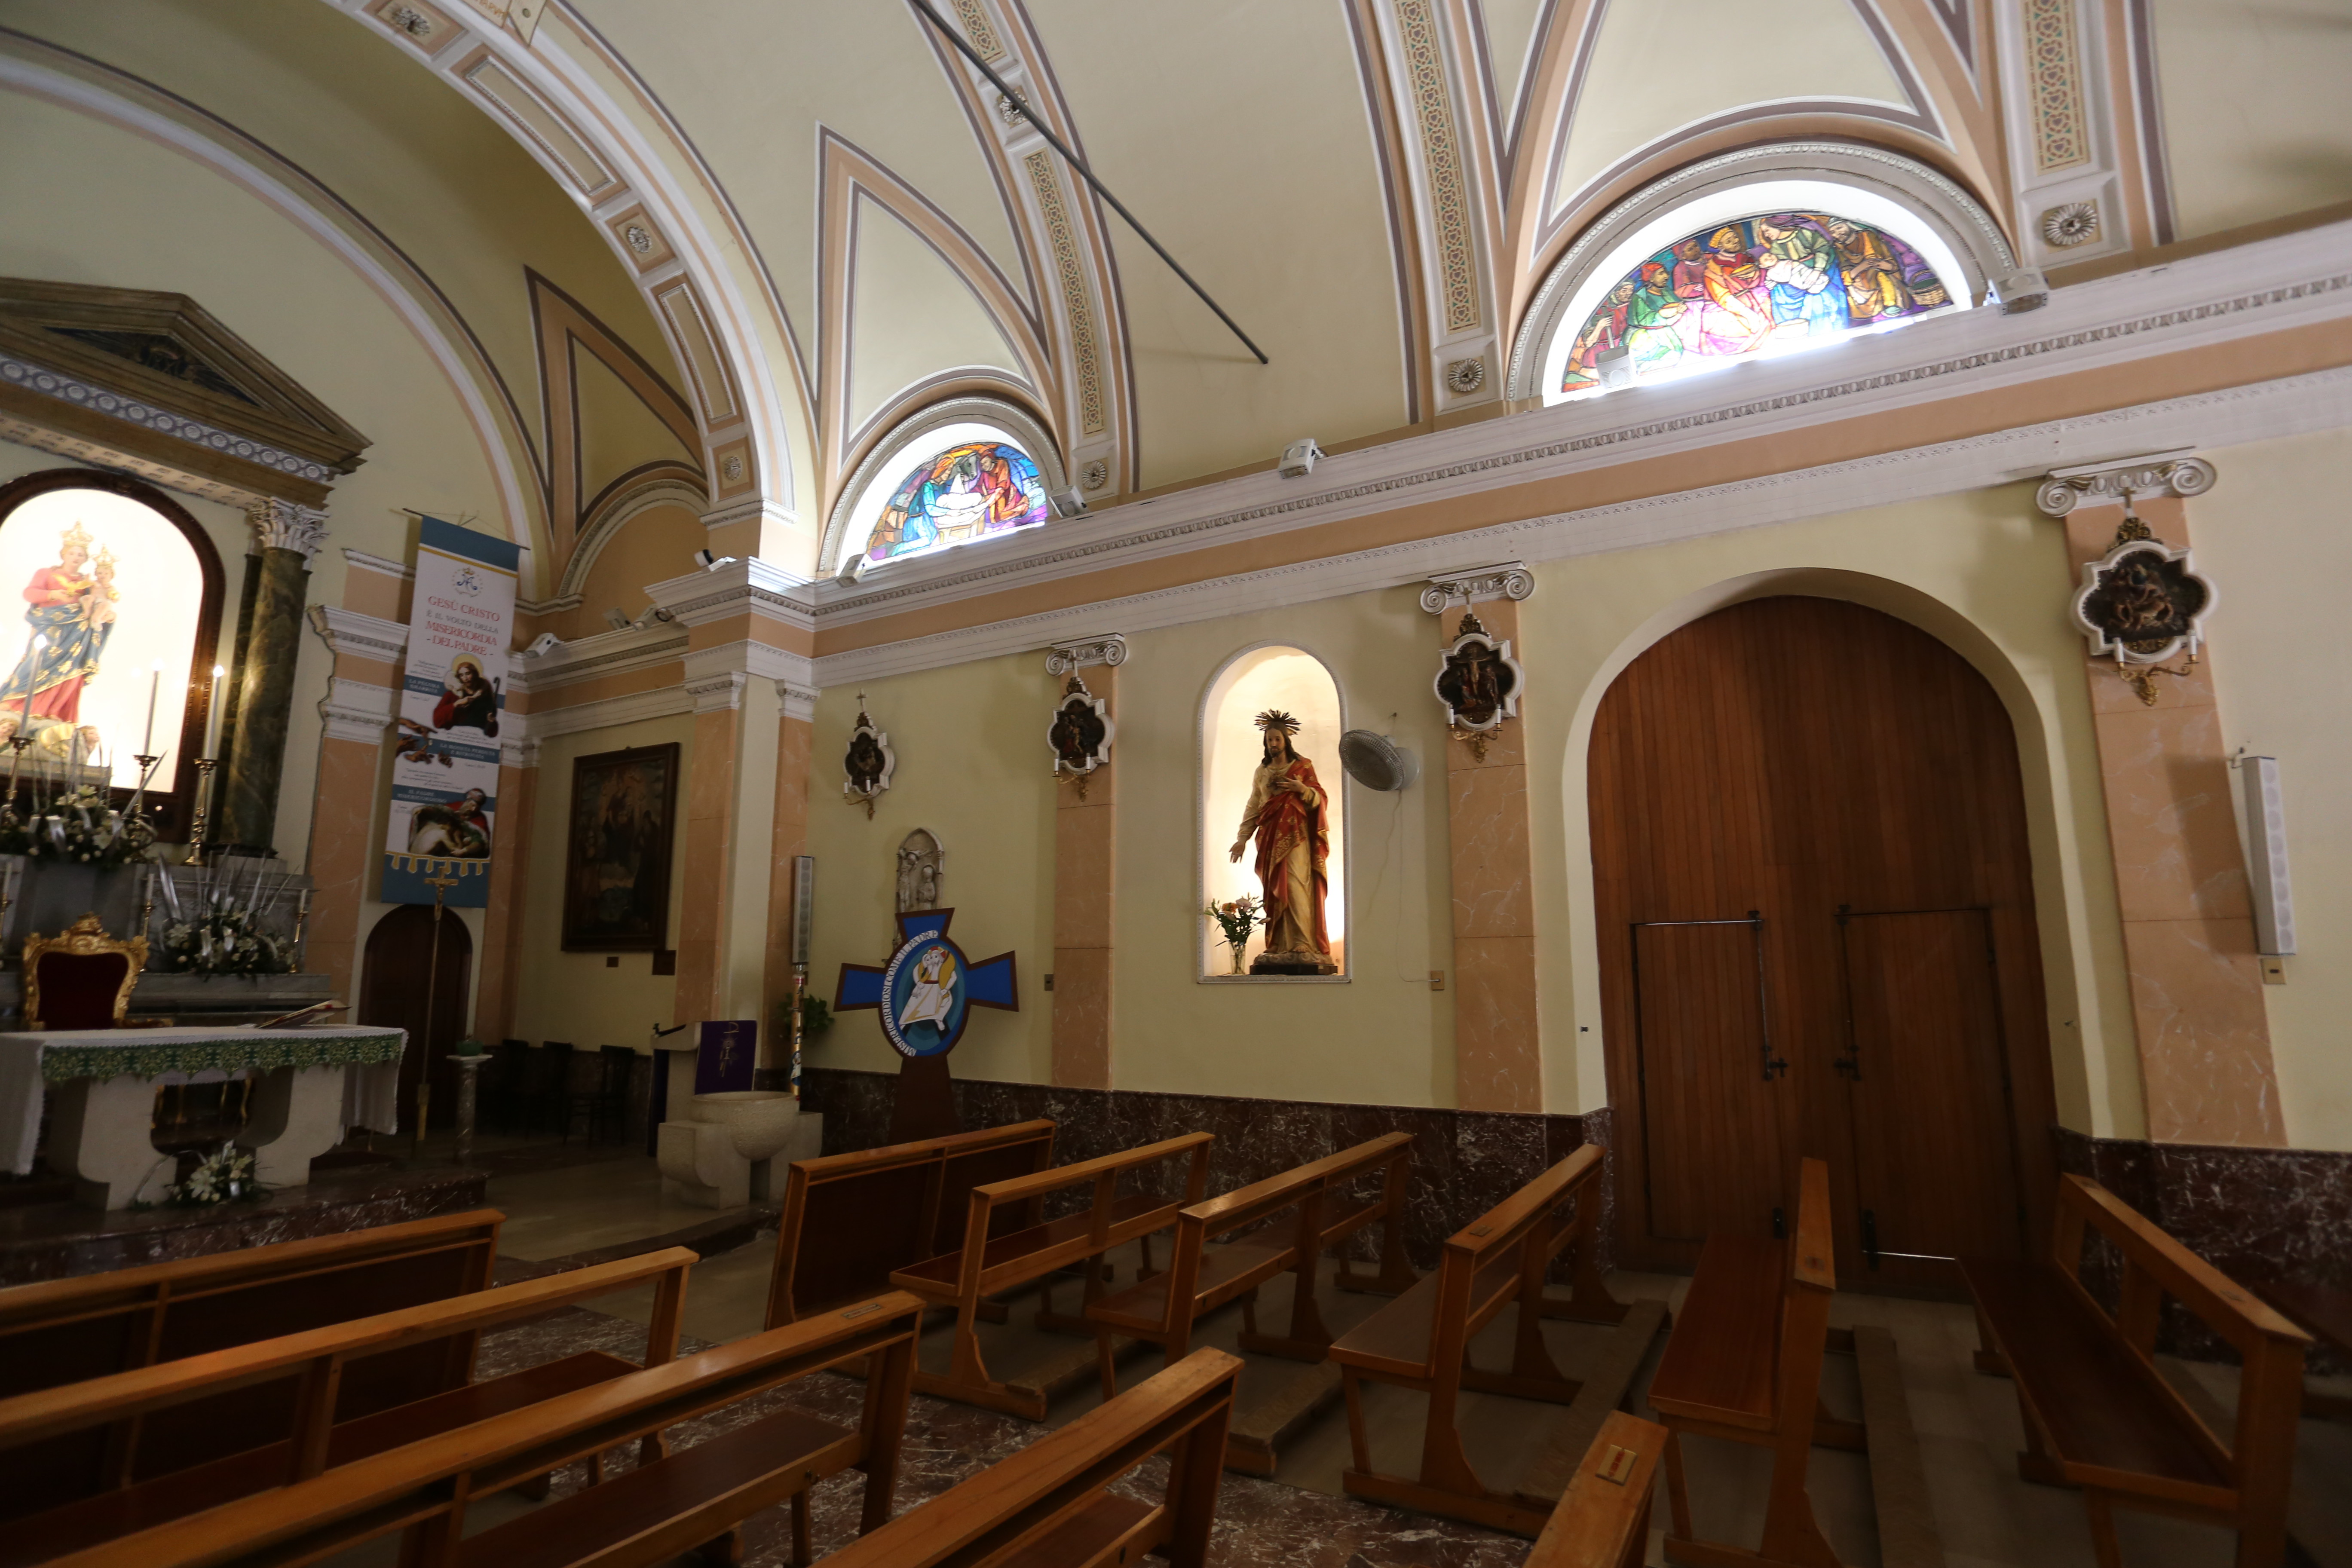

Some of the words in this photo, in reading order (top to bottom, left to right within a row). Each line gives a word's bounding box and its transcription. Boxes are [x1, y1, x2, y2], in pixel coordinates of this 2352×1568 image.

[435, 612, 443, 620] IL
[446, 615, 472, 627] VOLTO
[474, 622, 499, 634] DELLA
[460, 604, 500, 622] CRISTO
[426, 621, 497, 646] MISERICORDIA
[432, 635, 453, 648] DEL
[454, 640, 487, 655] PADRE
[909, 930, 938, 949] PADRE
[900, 946, 910, 956] IL
[885, 956, 903, 982] COME
[882, 984, 916, 1057] MISERICORDIOSI
